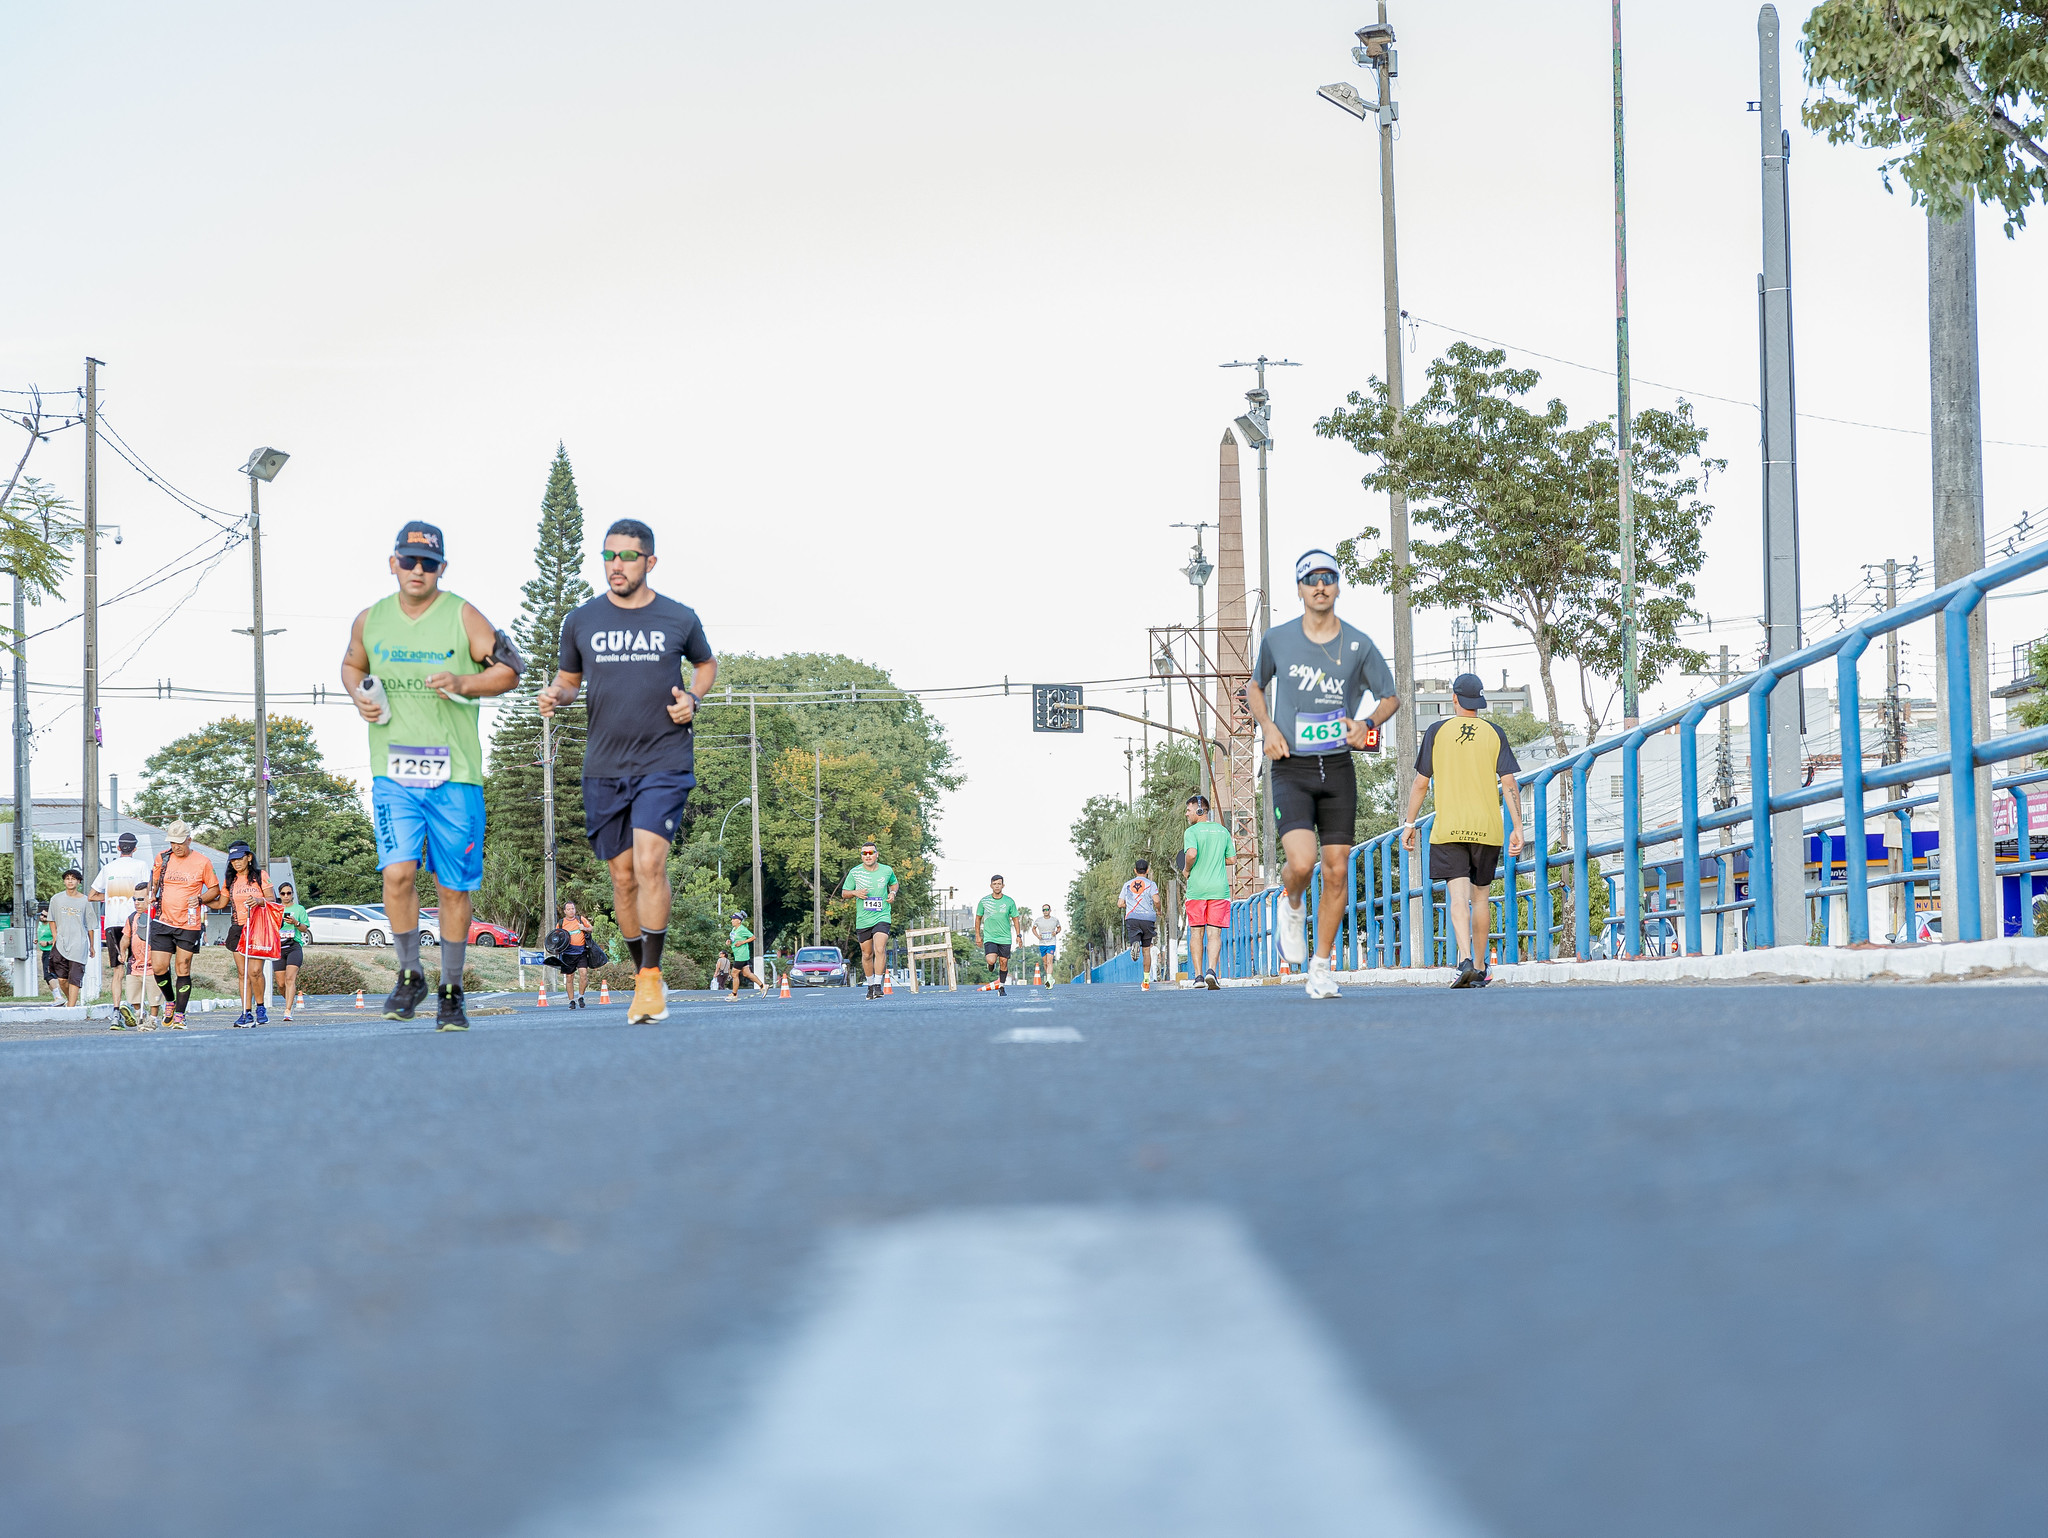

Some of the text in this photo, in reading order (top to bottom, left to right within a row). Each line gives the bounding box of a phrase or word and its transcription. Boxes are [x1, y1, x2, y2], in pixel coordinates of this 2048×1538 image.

[590, 629, 666, 652] GUIAR
[1301, 721, 1342, 741] 463
[392, 759, 445, 776] 1267
